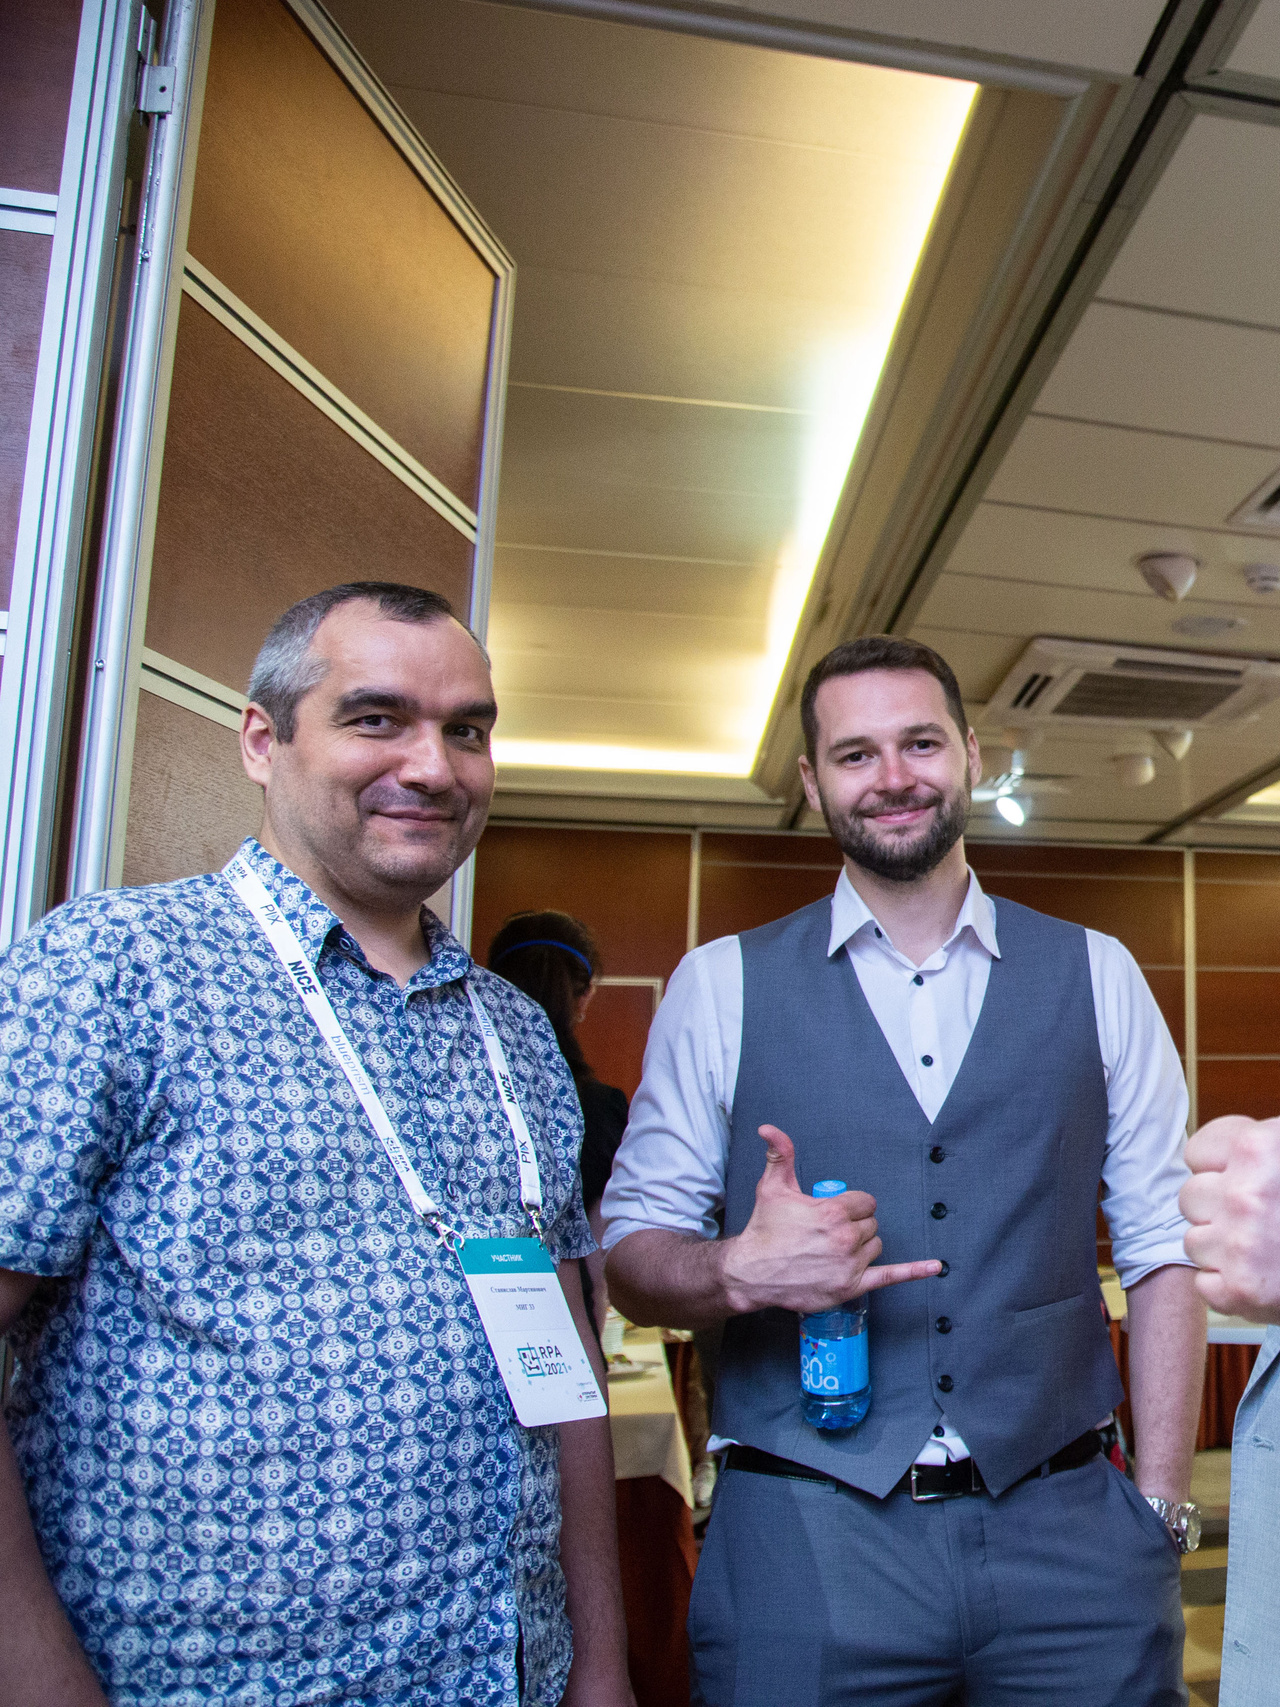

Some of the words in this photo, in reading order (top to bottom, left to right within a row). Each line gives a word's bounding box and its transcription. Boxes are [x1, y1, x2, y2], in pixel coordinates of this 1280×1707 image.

[259, 903, 284, 926] PIX
[287, 960, 319, 995] NICE
[329, 1034, 372, 1096] blueprism
[497, 1070, 517, 1105] NICE
[518, 1139, 532, 1164] PIX
[490, 1253, 524, 1263] УЧАСТНИК
[538, 1345, 563, 1359] RPA
[545, 1362, 569, 1375] 2021
[800, 1354, 823, 1374] on
[801, 1369, 840, 1390] qua
